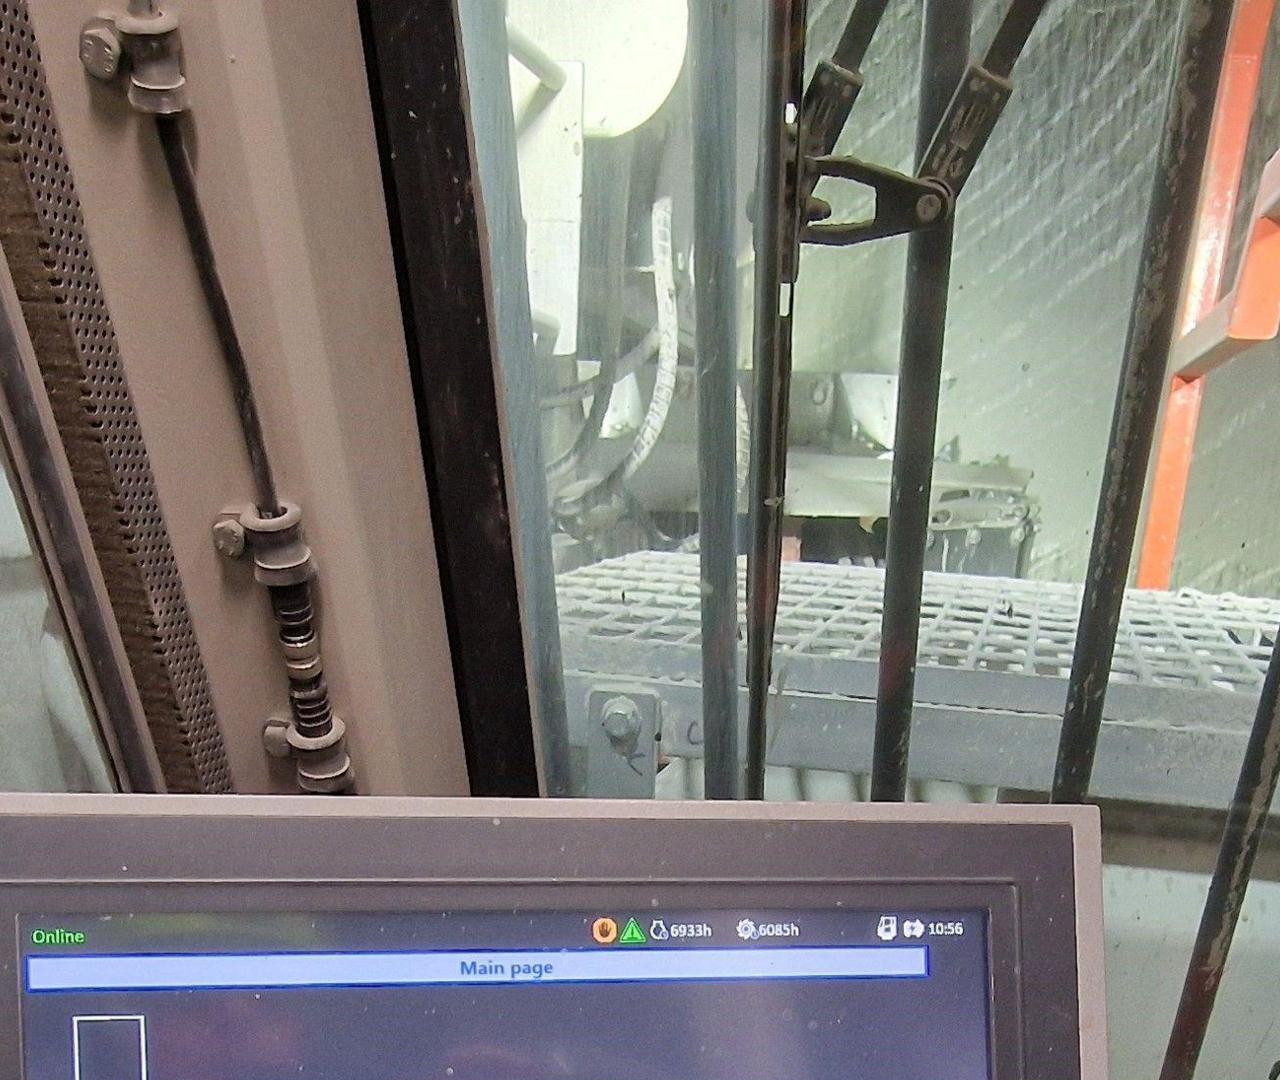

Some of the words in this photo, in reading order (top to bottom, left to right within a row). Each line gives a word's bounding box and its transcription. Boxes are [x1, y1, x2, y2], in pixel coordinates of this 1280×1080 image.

[32, 928, 85, 944] Online
[670, 922, 712, 938] 6933h
[758, 922, 800, 937] 6085h
[928, 921, 964, 936] 10:56
[460, 960, 505, 975] Main
[510, 963, 554, 979] page
